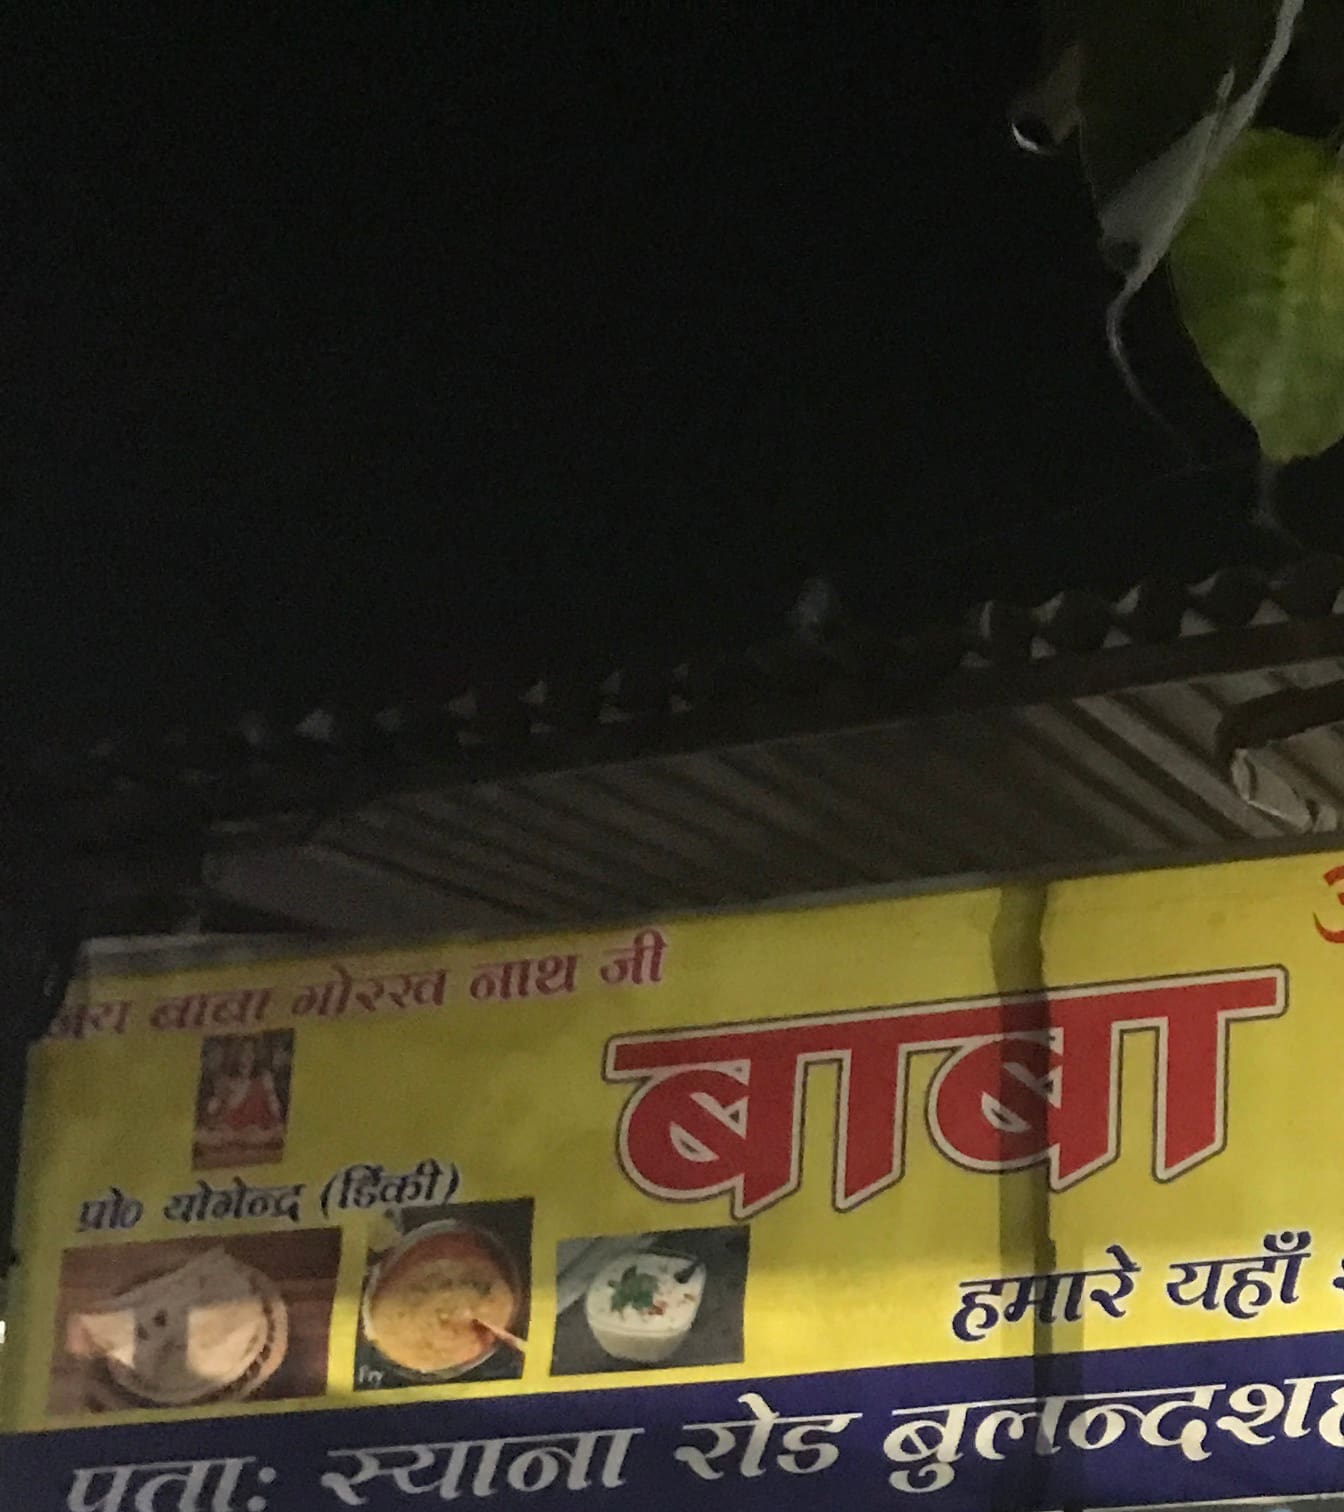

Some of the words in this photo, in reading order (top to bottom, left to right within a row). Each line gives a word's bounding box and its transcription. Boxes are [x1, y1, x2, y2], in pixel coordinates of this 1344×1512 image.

[149, 987, 273, 1029] बाबा
[291, 964, 449, 1018] गोरख
[469, 953, 578, 1003] नाथ
[600, 927, 668, 987] जी
[604, 964, 1288, 1221] बाबा
[163, 1176, 306, 1223] योगेन्द्र
[950, 1243, 1141, 1344] हमारे
[1166, 1230, 1312, 1317] यहाँ
[320, 1425, 646, 1506] स्याना
[674, 1393, 864, 1479] रोड
